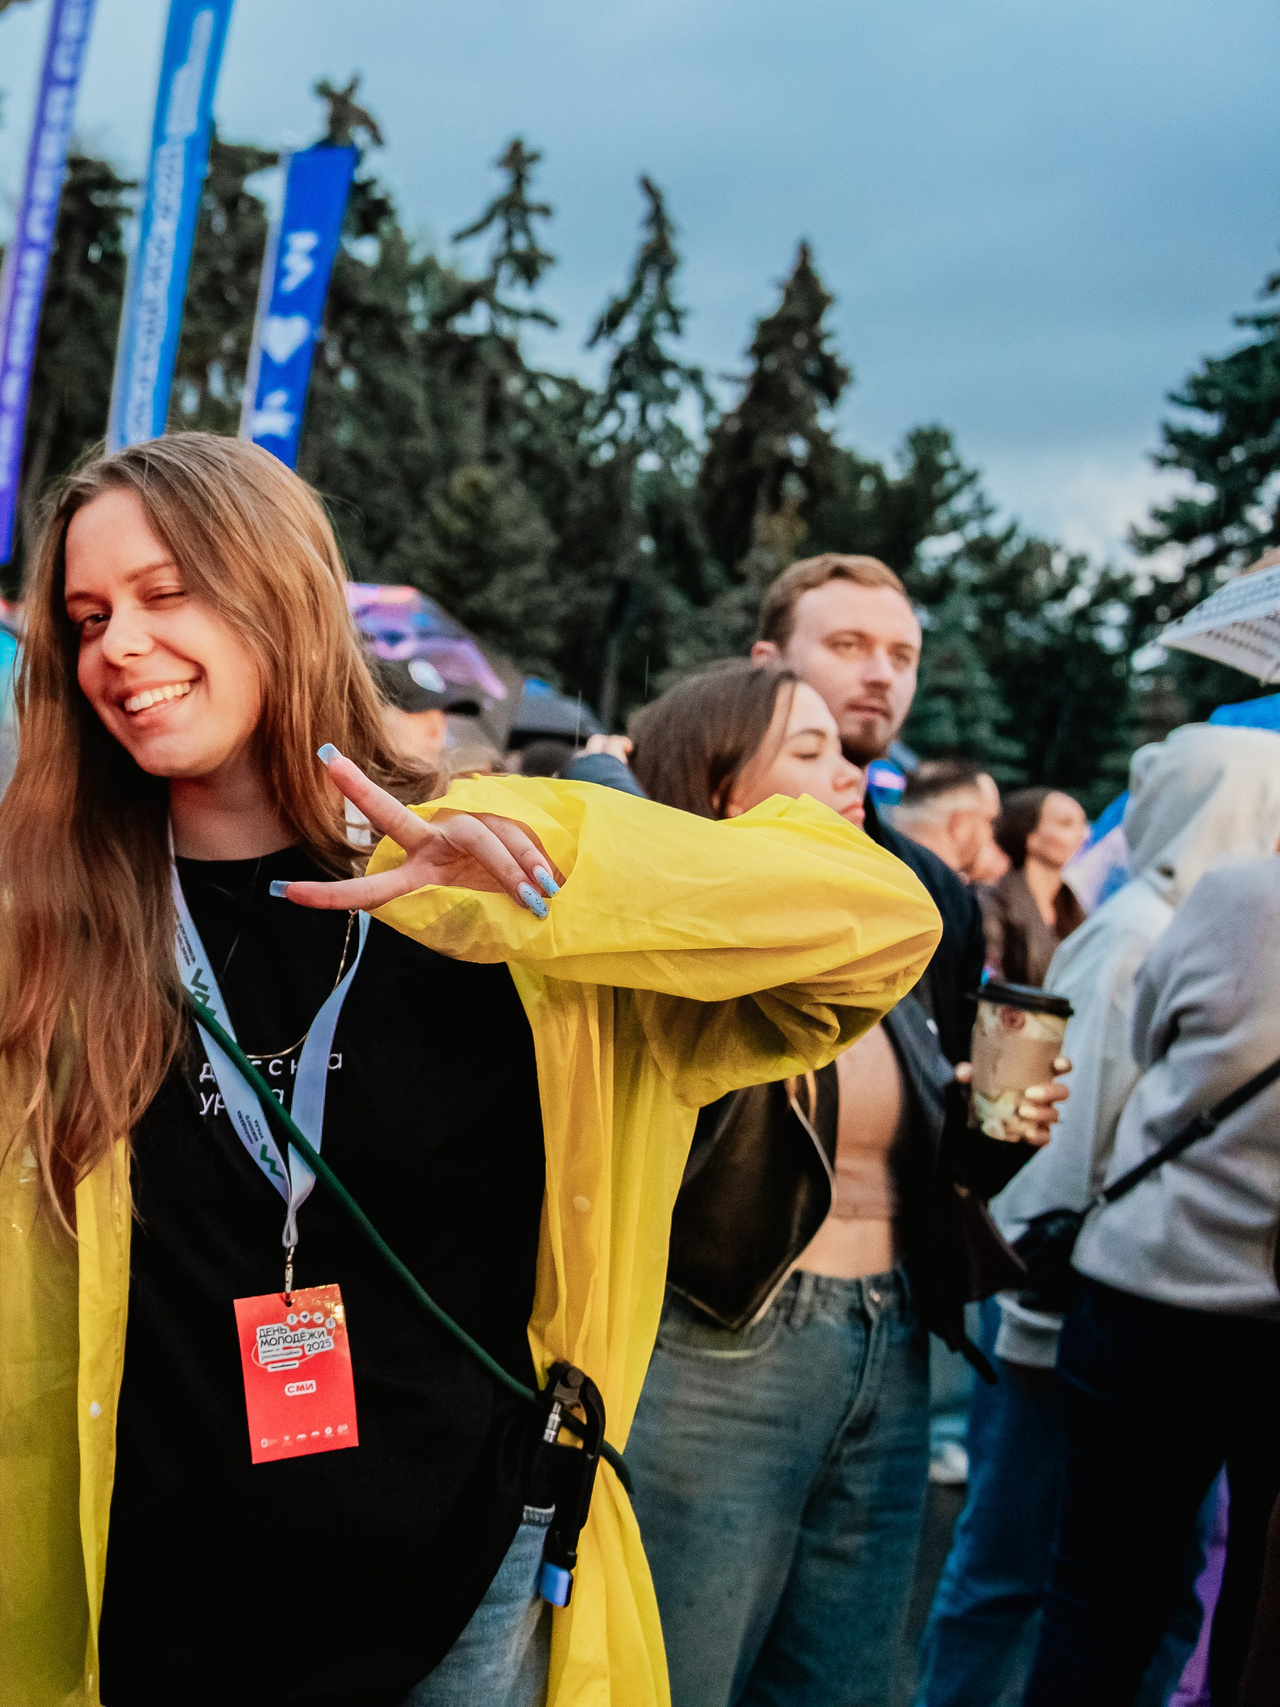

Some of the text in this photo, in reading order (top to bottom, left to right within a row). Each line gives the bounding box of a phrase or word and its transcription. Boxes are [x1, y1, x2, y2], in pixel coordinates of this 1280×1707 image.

[259, 1326, 288, 1339] ДЕНЬ
[306, 1339, 332, 1353] 2025
[287, 1383, 314, 1393] СМИ
